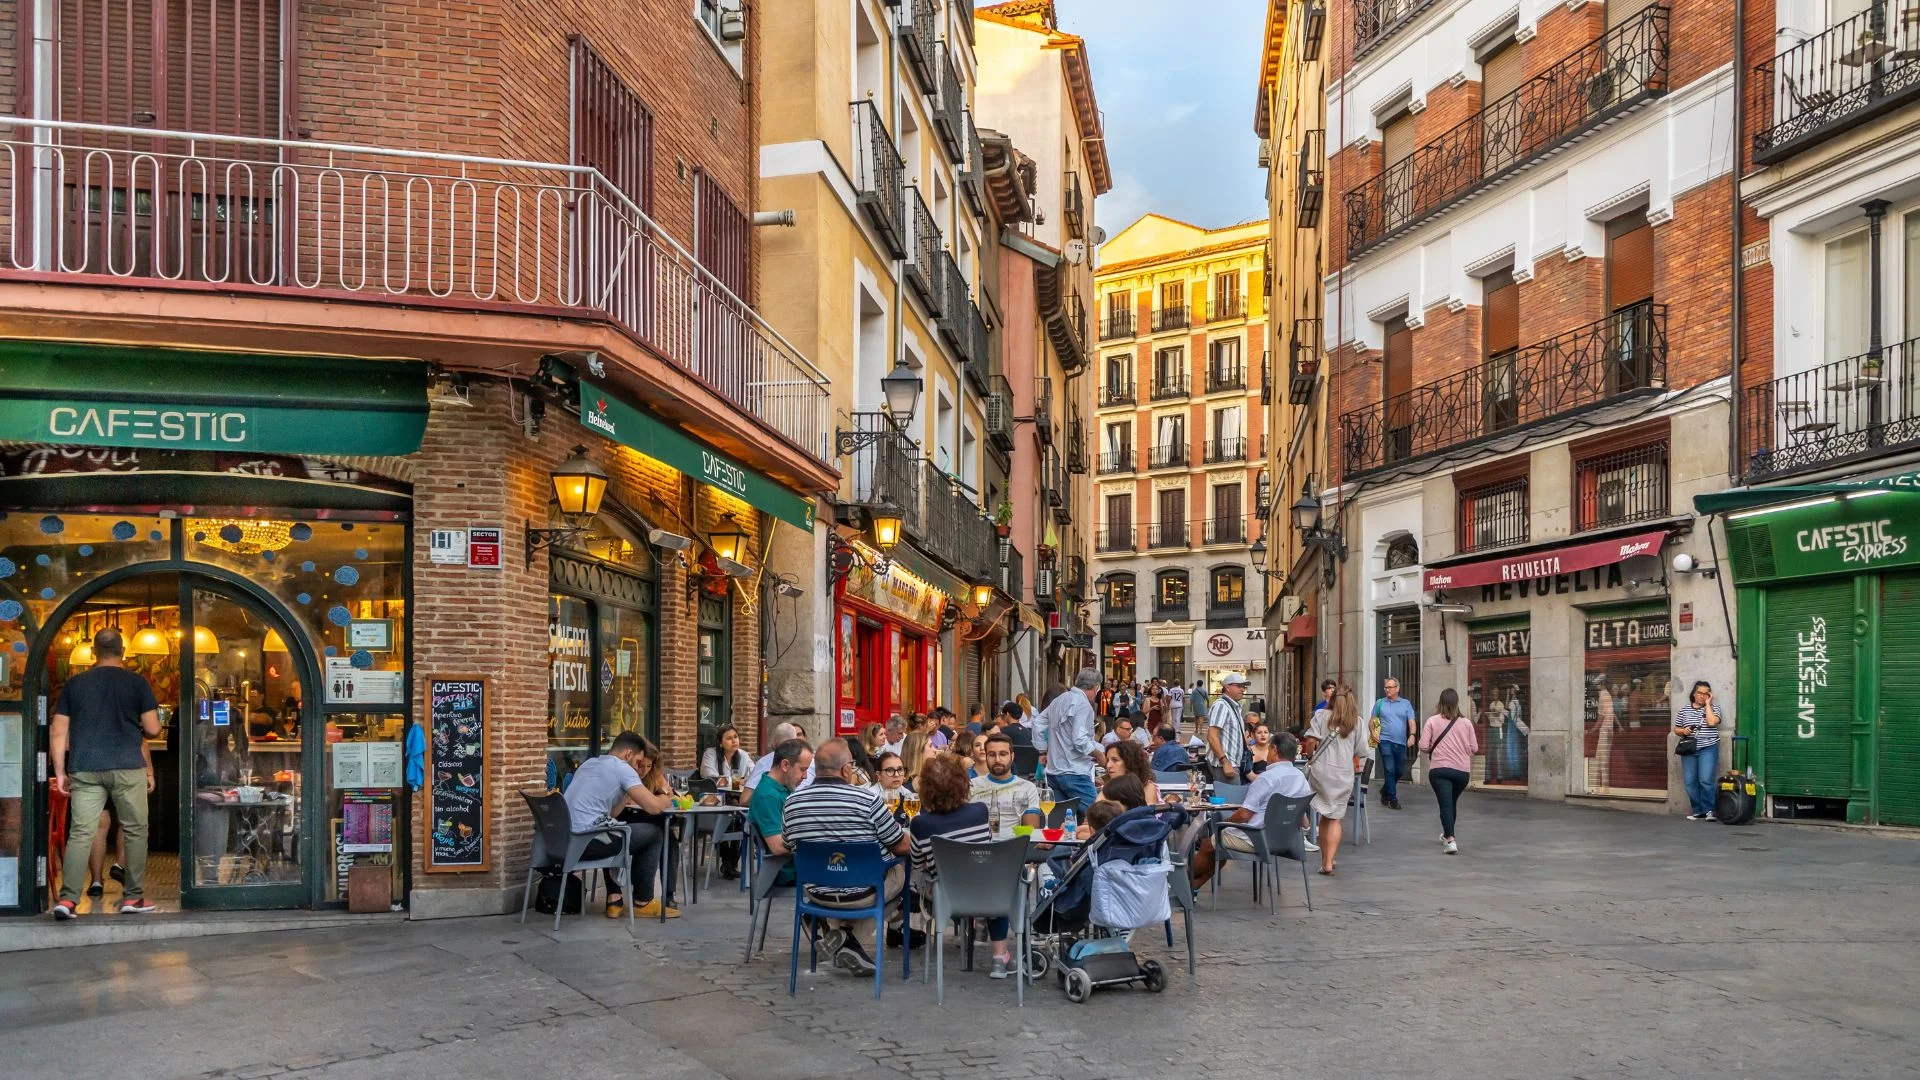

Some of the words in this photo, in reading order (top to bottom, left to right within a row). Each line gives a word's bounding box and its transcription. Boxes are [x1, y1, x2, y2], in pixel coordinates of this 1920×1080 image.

[50, 407, 247, 443] CAFESTIC
[588, 410, 616, 435] Heineken
[702, 451, 746, 492] CAFESTIC
[1796, 519, 1893, 552] CAFESTIC
[1620, 541, 1650, 556] Mahou
[1843, 536, 1907, 564] EXPRESS
[1502, 557, 1561, 581] REVUELTA
[1391, 581, 1397, 592] 3
[1210, 638, 1229, 650] Rin
[1475, 640, 1496, 653] VINOS
[1812, 616, 1830, 687] EXPRESS
[434, 682, 480, 693] CAFESTIC
[553, 660, 588, 692] FIESTA
[1798, 632, 1816, 739] CAFESTIC
[1174, 692, 1182, 702] 12
